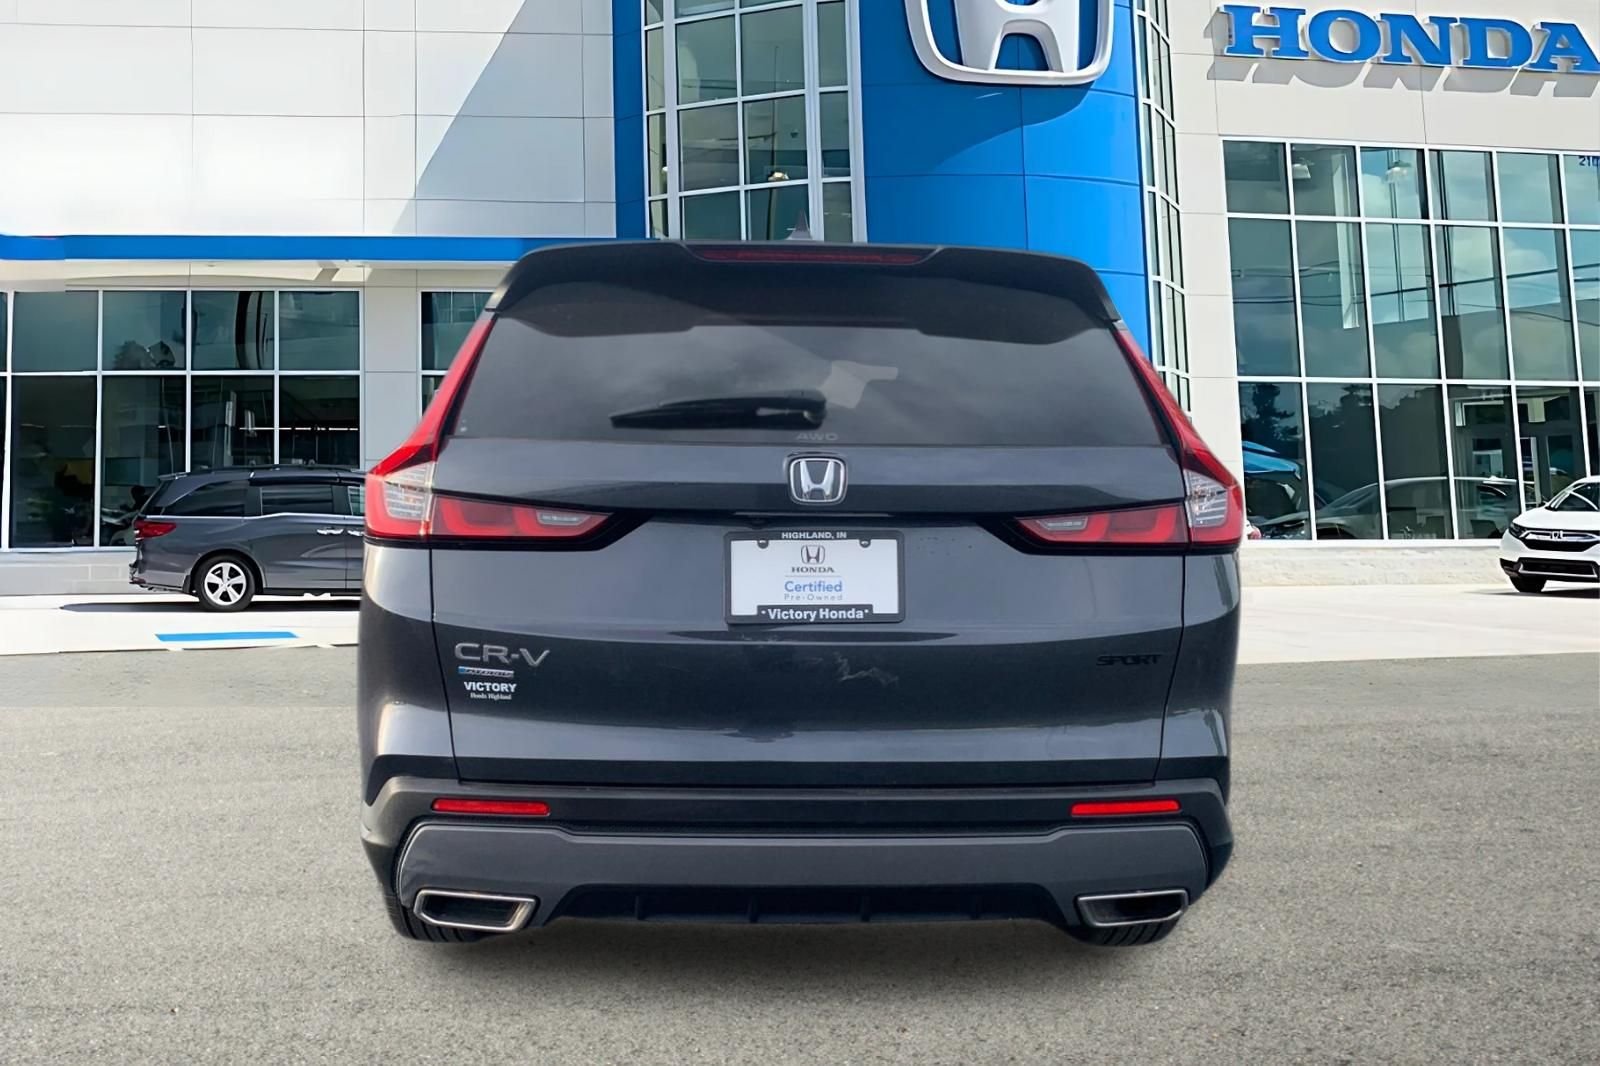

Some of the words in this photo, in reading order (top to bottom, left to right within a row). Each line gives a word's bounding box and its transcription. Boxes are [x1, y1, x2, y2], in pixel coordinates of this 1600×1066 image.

[1221, 4, 1600, 74] HONDA
[796, 432, 838, 441] AWD
[781, 532, 835, 540] HIGHLAND,
[784, 580, 843, 593] Certified
[768, 608, 817, 622] Victory
[819, 608, 864, 619] Honda
[455, 642, 550, 667] CR-V
[1096, 654, 1162, 666] SPORT
[463, 681, 517, 693] VICTORY
